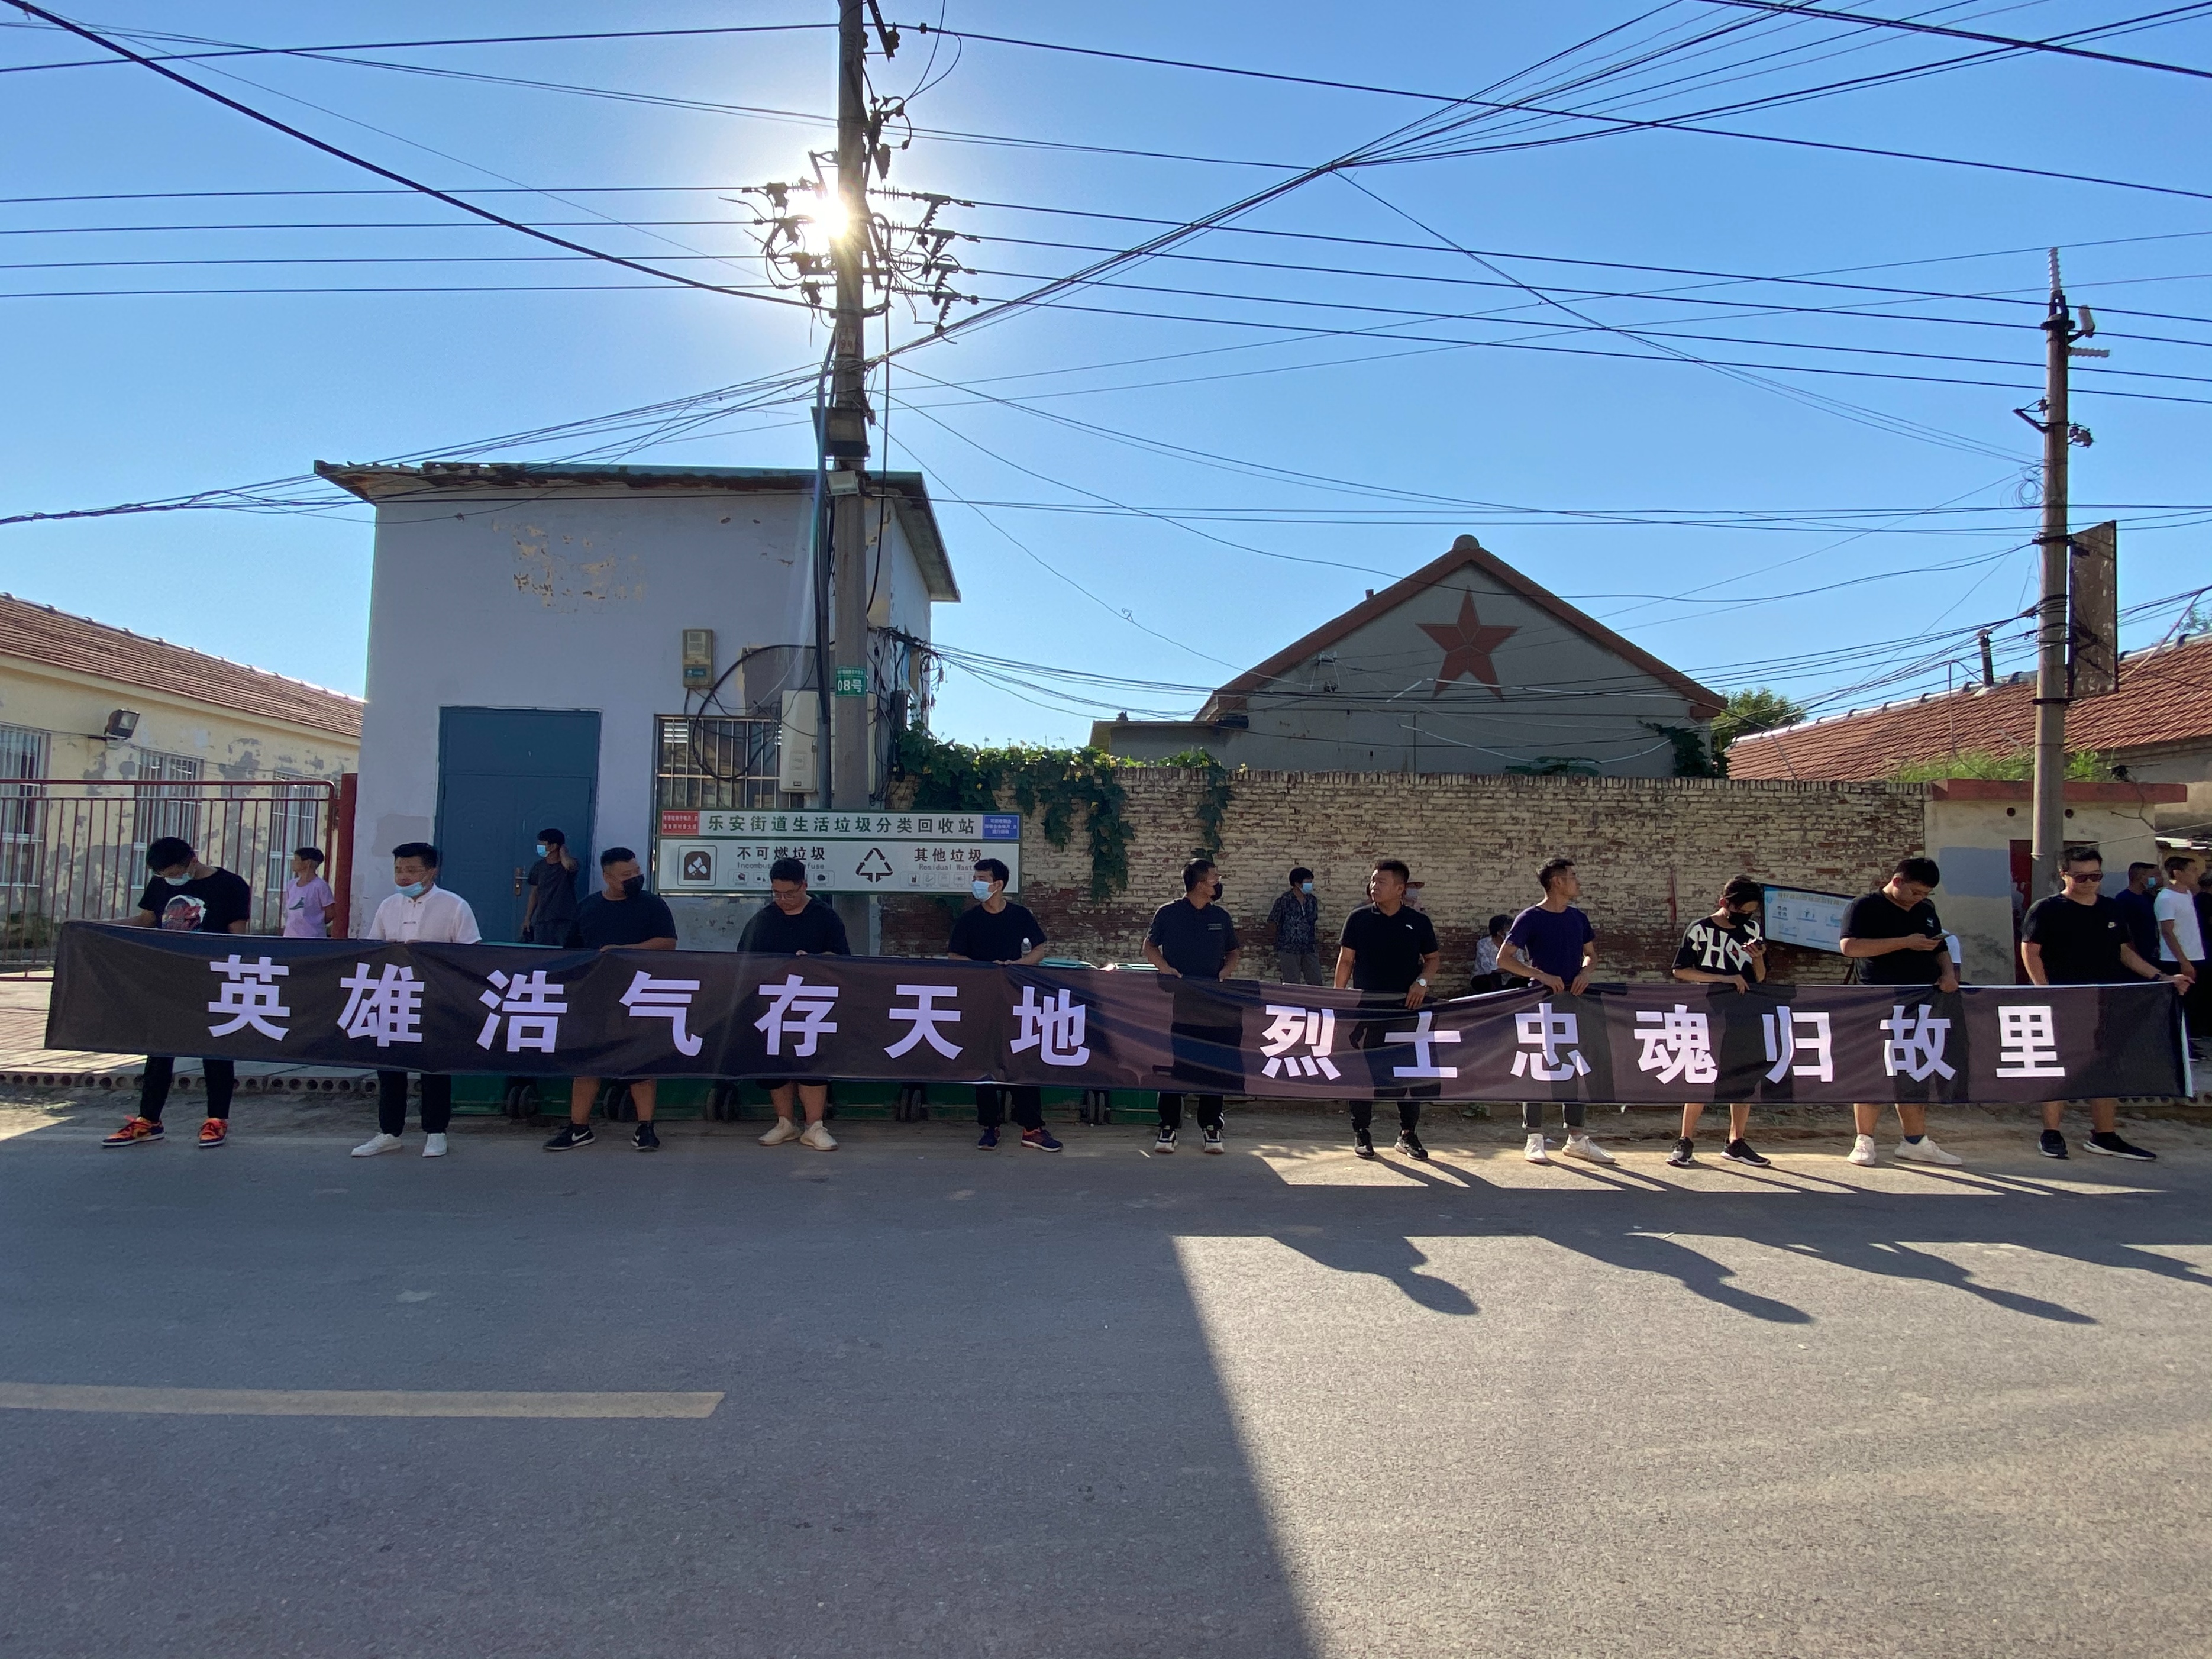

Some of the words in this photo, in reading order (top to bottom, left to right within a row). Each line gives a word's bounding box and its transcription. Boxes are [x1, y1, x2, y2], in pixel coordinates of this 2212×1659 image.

[837, 679, 863, 693] 08号
[708, 815, 974, 834] 乐安街道生活垃圾分类回收站
[737, 846, 825, 860] 不可燃垃圾
[915, 848, 981, 862] 其他垃圾
[208, 954, 1090, 1066] 英雄浩气存天地
[1260, 1003, 2065, 1085] 烈士忠魂归故里
